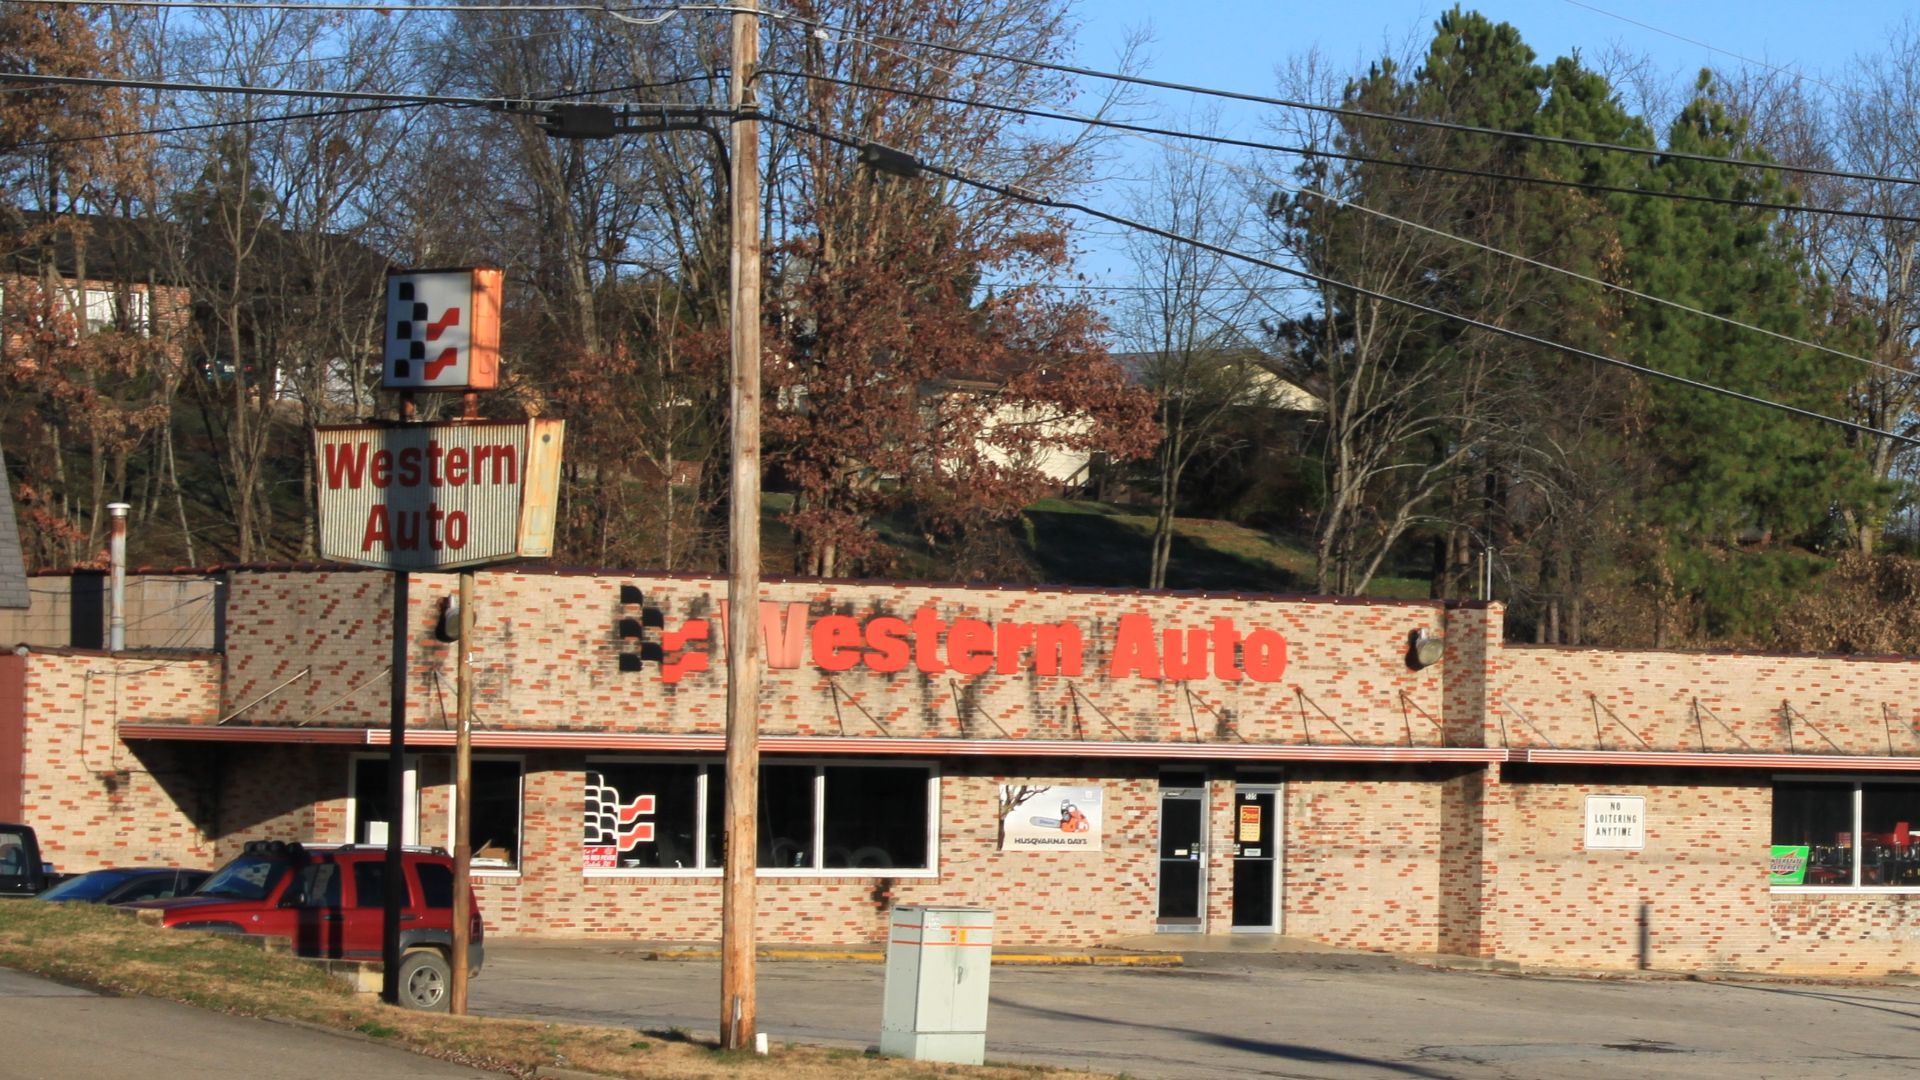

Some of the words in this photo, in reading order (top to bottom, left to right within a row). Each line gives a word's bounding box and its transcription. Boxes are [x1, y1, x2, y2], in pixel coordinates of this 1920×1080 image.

[325, 440, 517, 490] Western
[361, 504, 468, 552] Auto
[720, 599, 1083, 677] Western
[1110, 613, 1287, 682] Auto
[1610, 802, 1621, 811] NO
[1595, 814, 1637, 823] LOITERING
[1596, 827, 1632, 836] ANYTIME
[1014, 837, 1066, 845] HUSQVARNA
